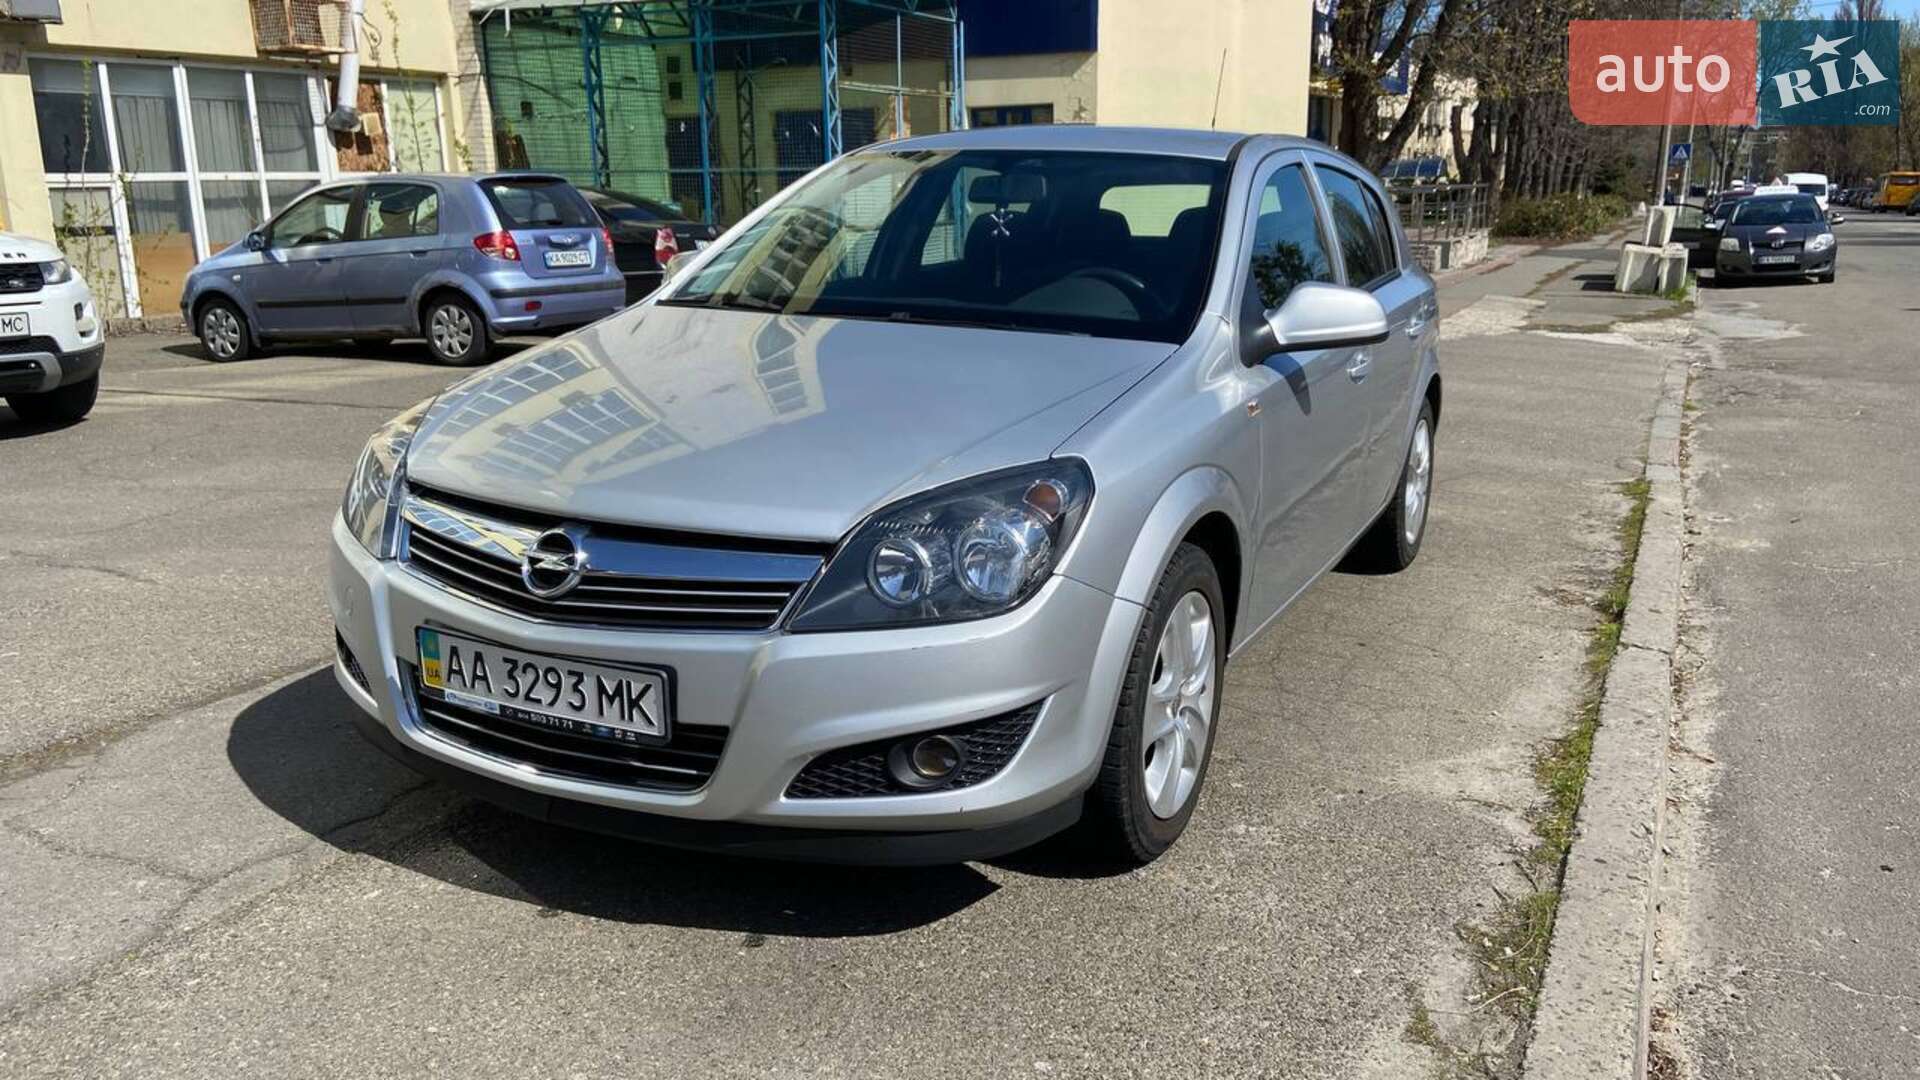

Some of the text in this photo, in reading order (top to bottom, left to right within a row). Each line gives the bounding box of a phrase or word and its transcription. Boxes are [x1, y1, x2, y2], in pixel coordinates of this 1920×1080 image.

[1, 317, 24, 333] MC
[446, 645, 656, 727] AA 3293 MK
